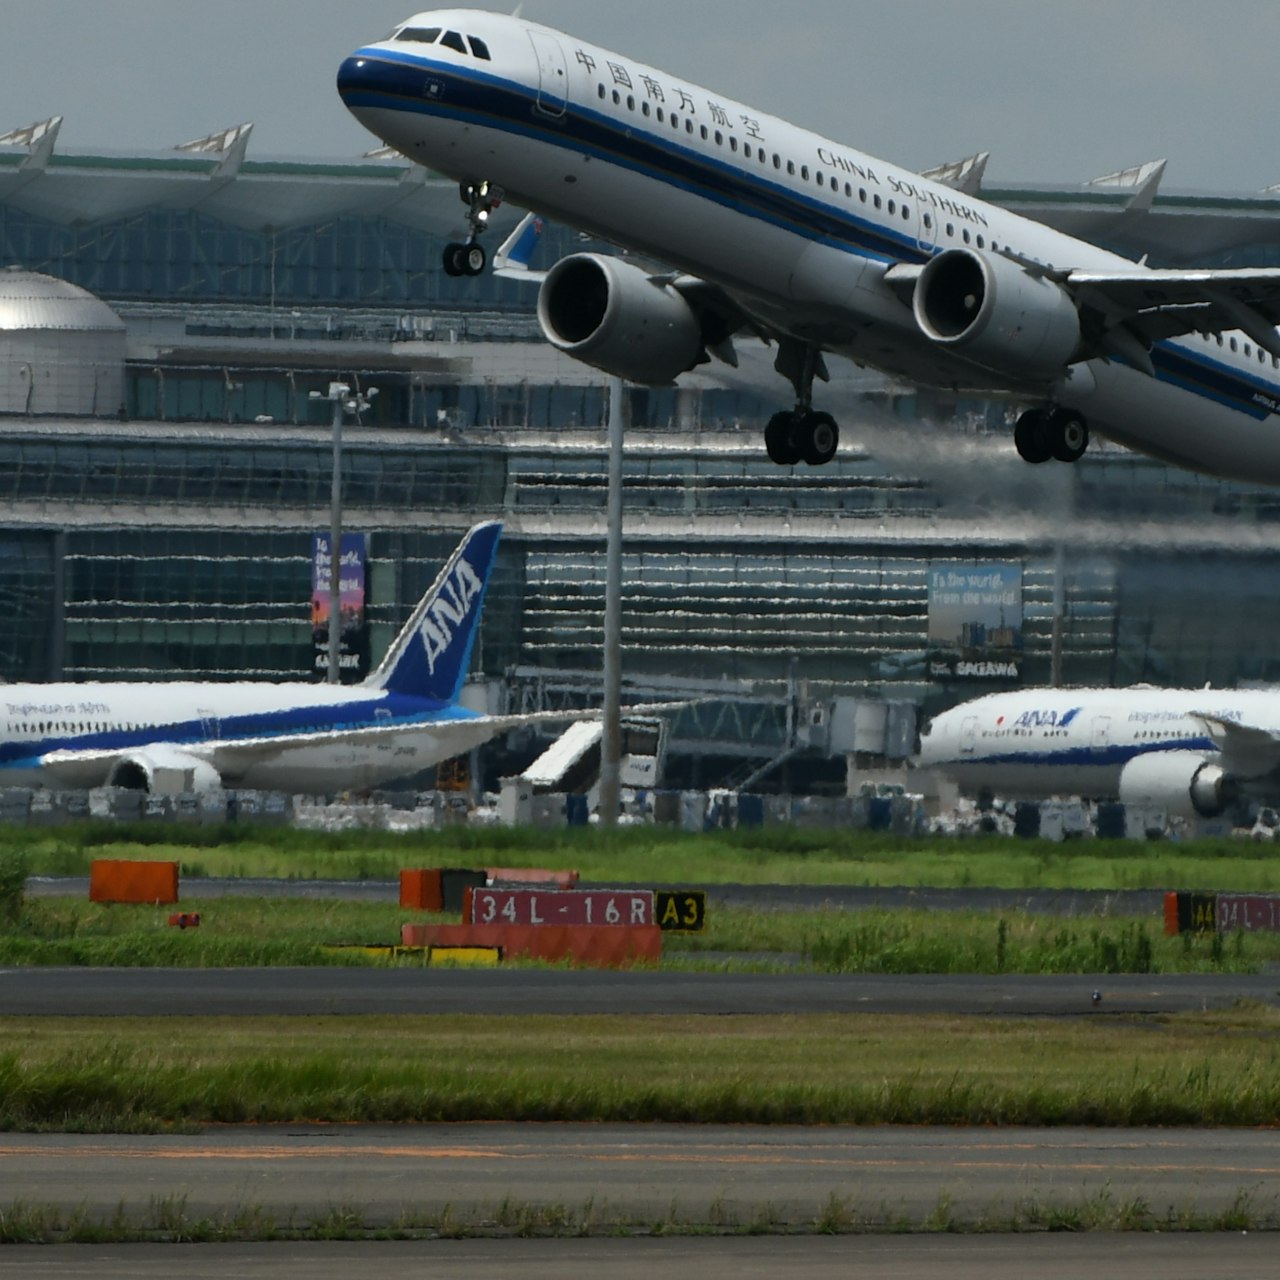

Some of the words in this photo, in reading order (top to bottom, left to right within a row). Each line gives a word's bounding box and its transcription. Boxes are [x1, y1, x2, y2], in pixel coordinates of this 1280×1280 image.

[575, 48, 765, 141] 中国南方航空
[817, 147, 881, 184] CHINA
[887, 175, 989, 228] SOUTHERN
[420, 558, 482, 676] ANA
[955, 661, 1019, 678] SAGAWA
[1014, 709, 1060, 728] ANA
[661, 896, 698, 925] A3
